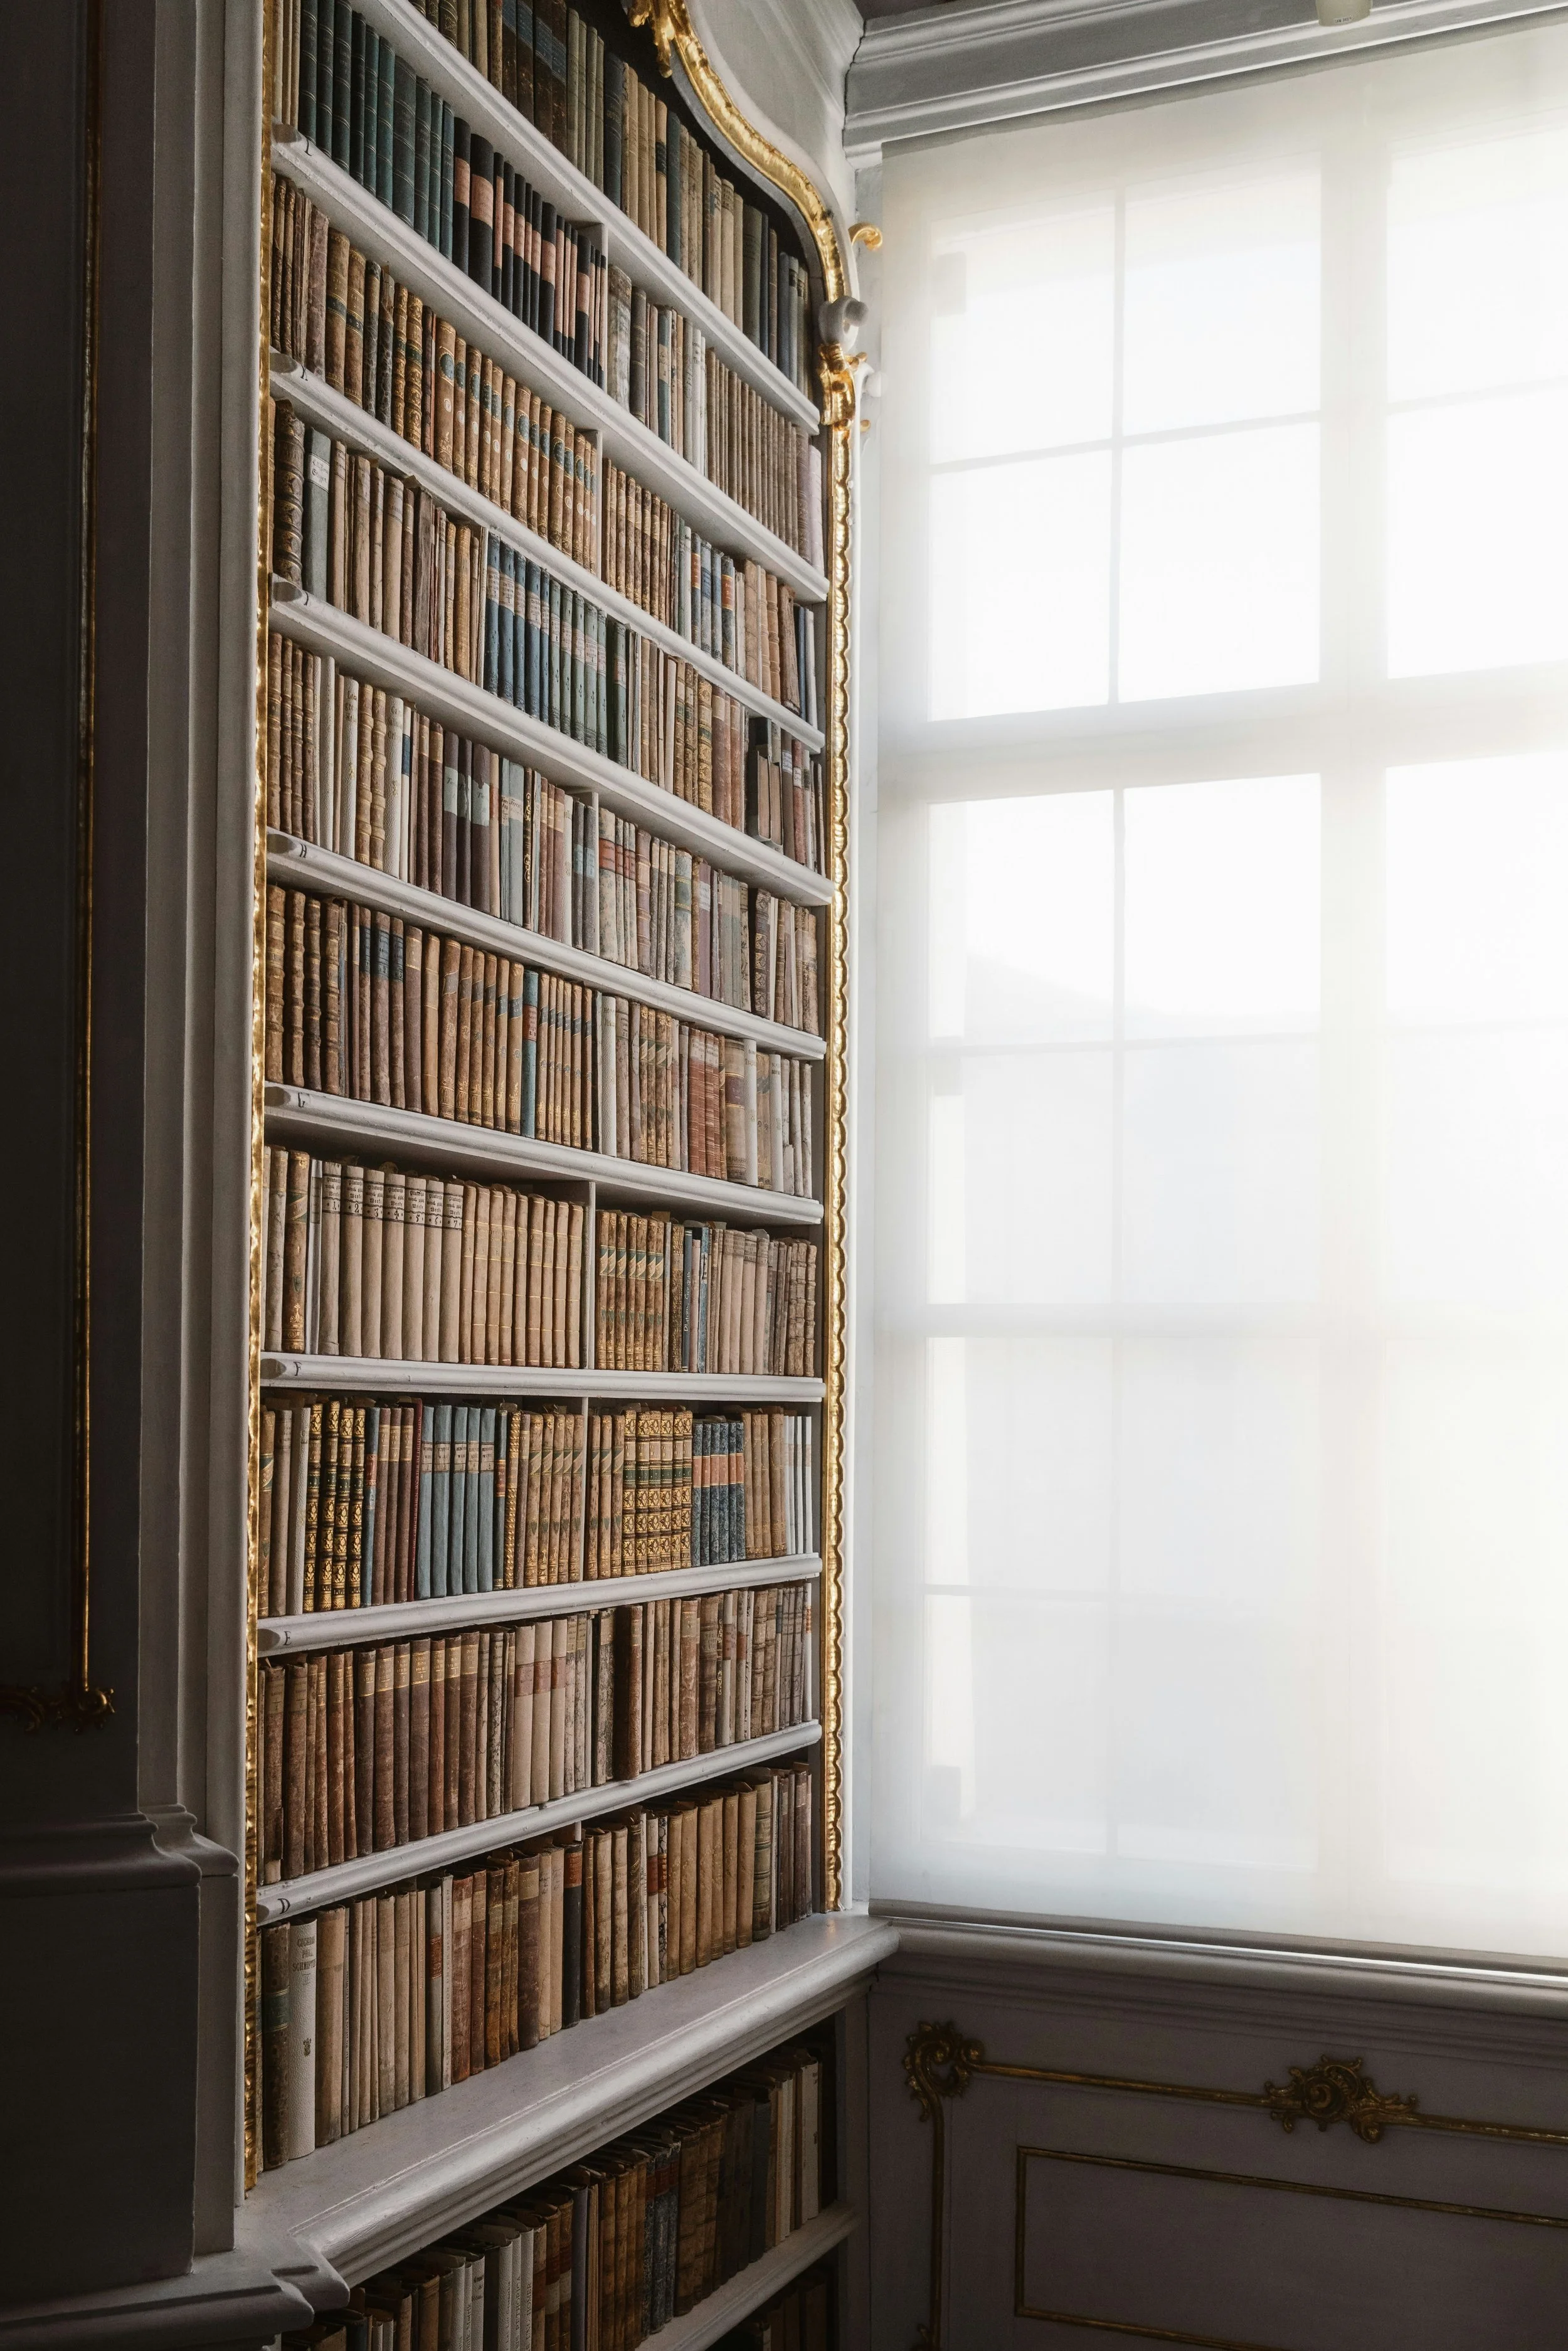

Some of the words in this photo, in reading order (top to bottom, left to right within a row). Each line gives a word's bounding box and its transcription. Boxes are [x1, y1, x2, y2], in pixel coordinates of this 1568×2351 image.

[299, 842, 307, 858] H
[297, 1091, 305, 1107] G
[292, 1361, 302, 1376] F
[283, 1630, 292, 1646] E
[277, 1897, 291, 1914] D
